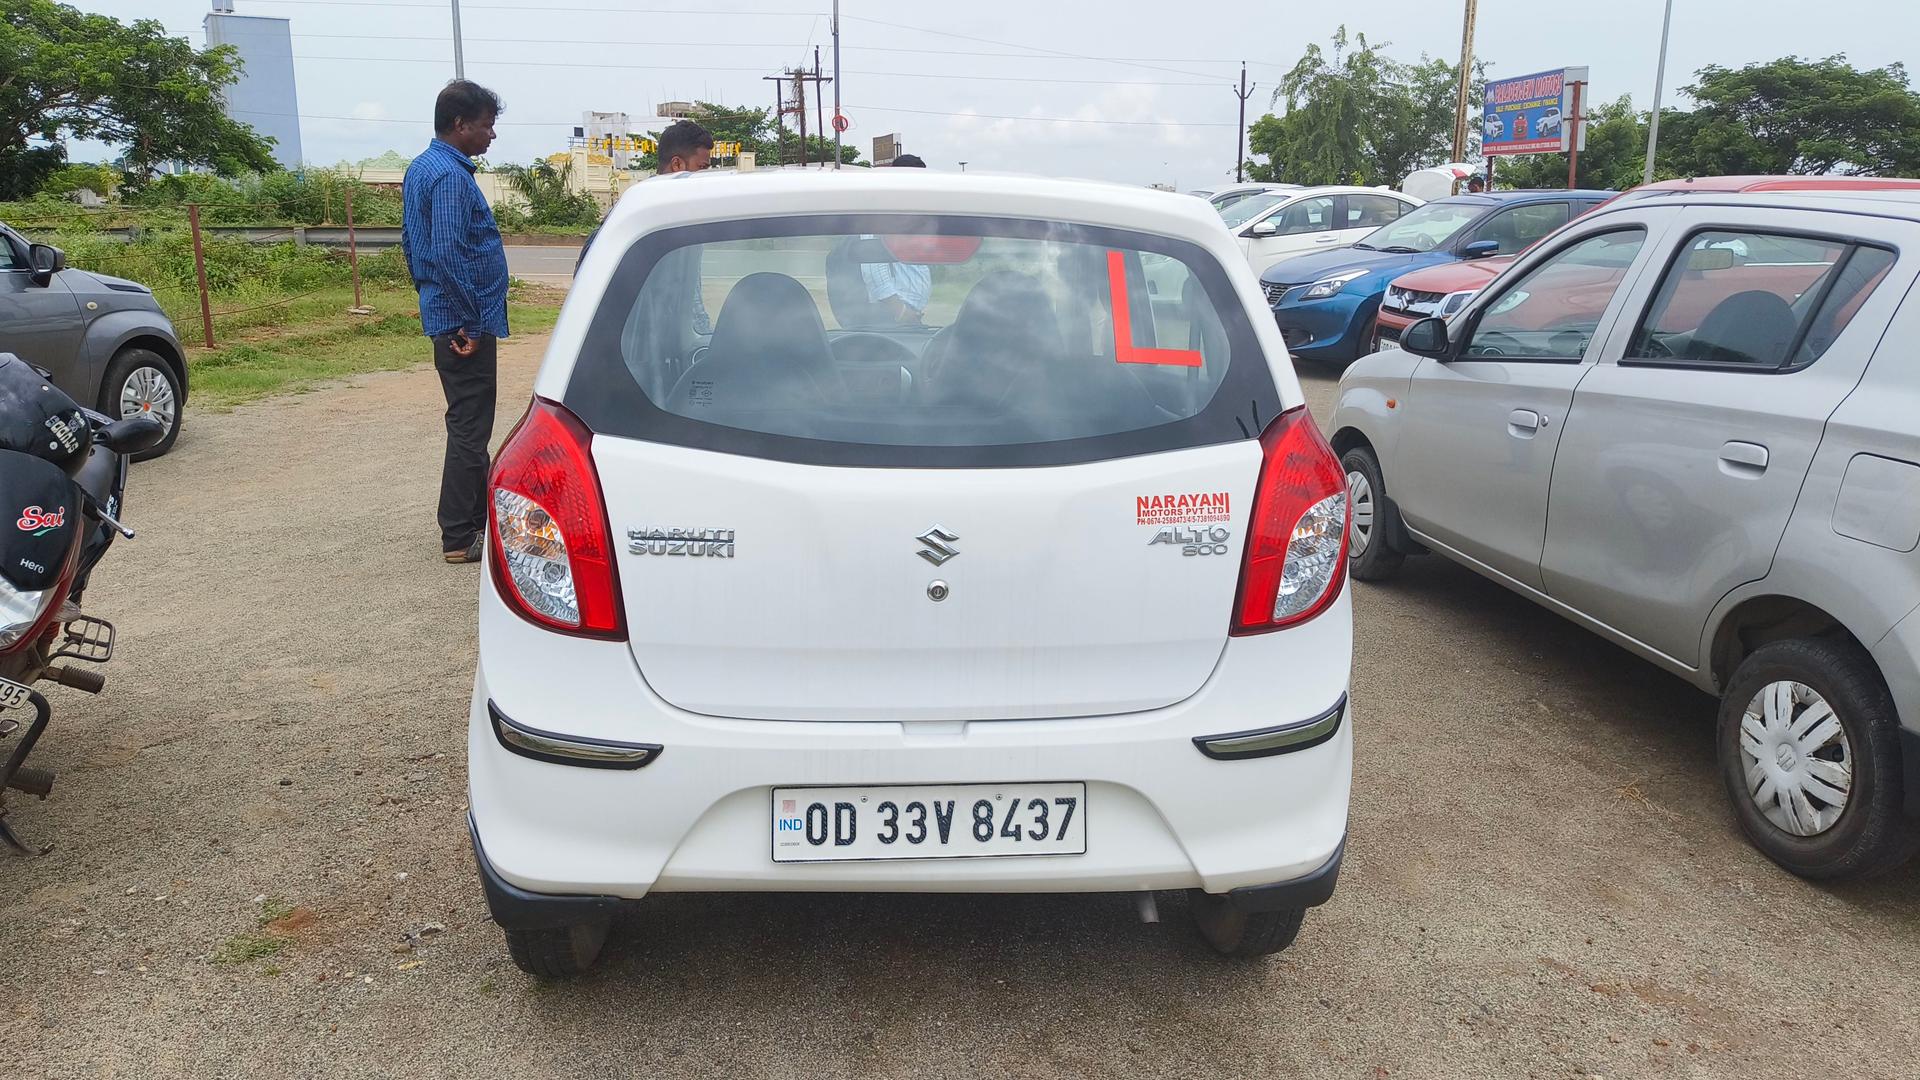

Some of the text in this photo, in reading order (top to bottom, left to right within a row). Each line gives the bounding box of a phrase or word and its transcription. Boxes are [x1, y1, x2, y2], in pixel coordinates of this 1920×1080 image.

[1535, 73, 1563, 98] MOTORS
[1137, 492, 1230, 517] NARAYANI
[1142, 506, 1224, 517] MOTORS PVT LTD
[17, 505, 65, 531] Sai
[627, 525, 735, 541] MARUTI
[1147, 525, 1231, 545] ALTO
[628, 540, 735, 558] SUZUKI
[1182, 544, 1228, 556] 800
[20, 558, 45, 574] Hero
[0, 683, 25, 705] 95
[779, 818, 803, 831] IND
[806, 797, 1077, 846] OD 33V 8437
